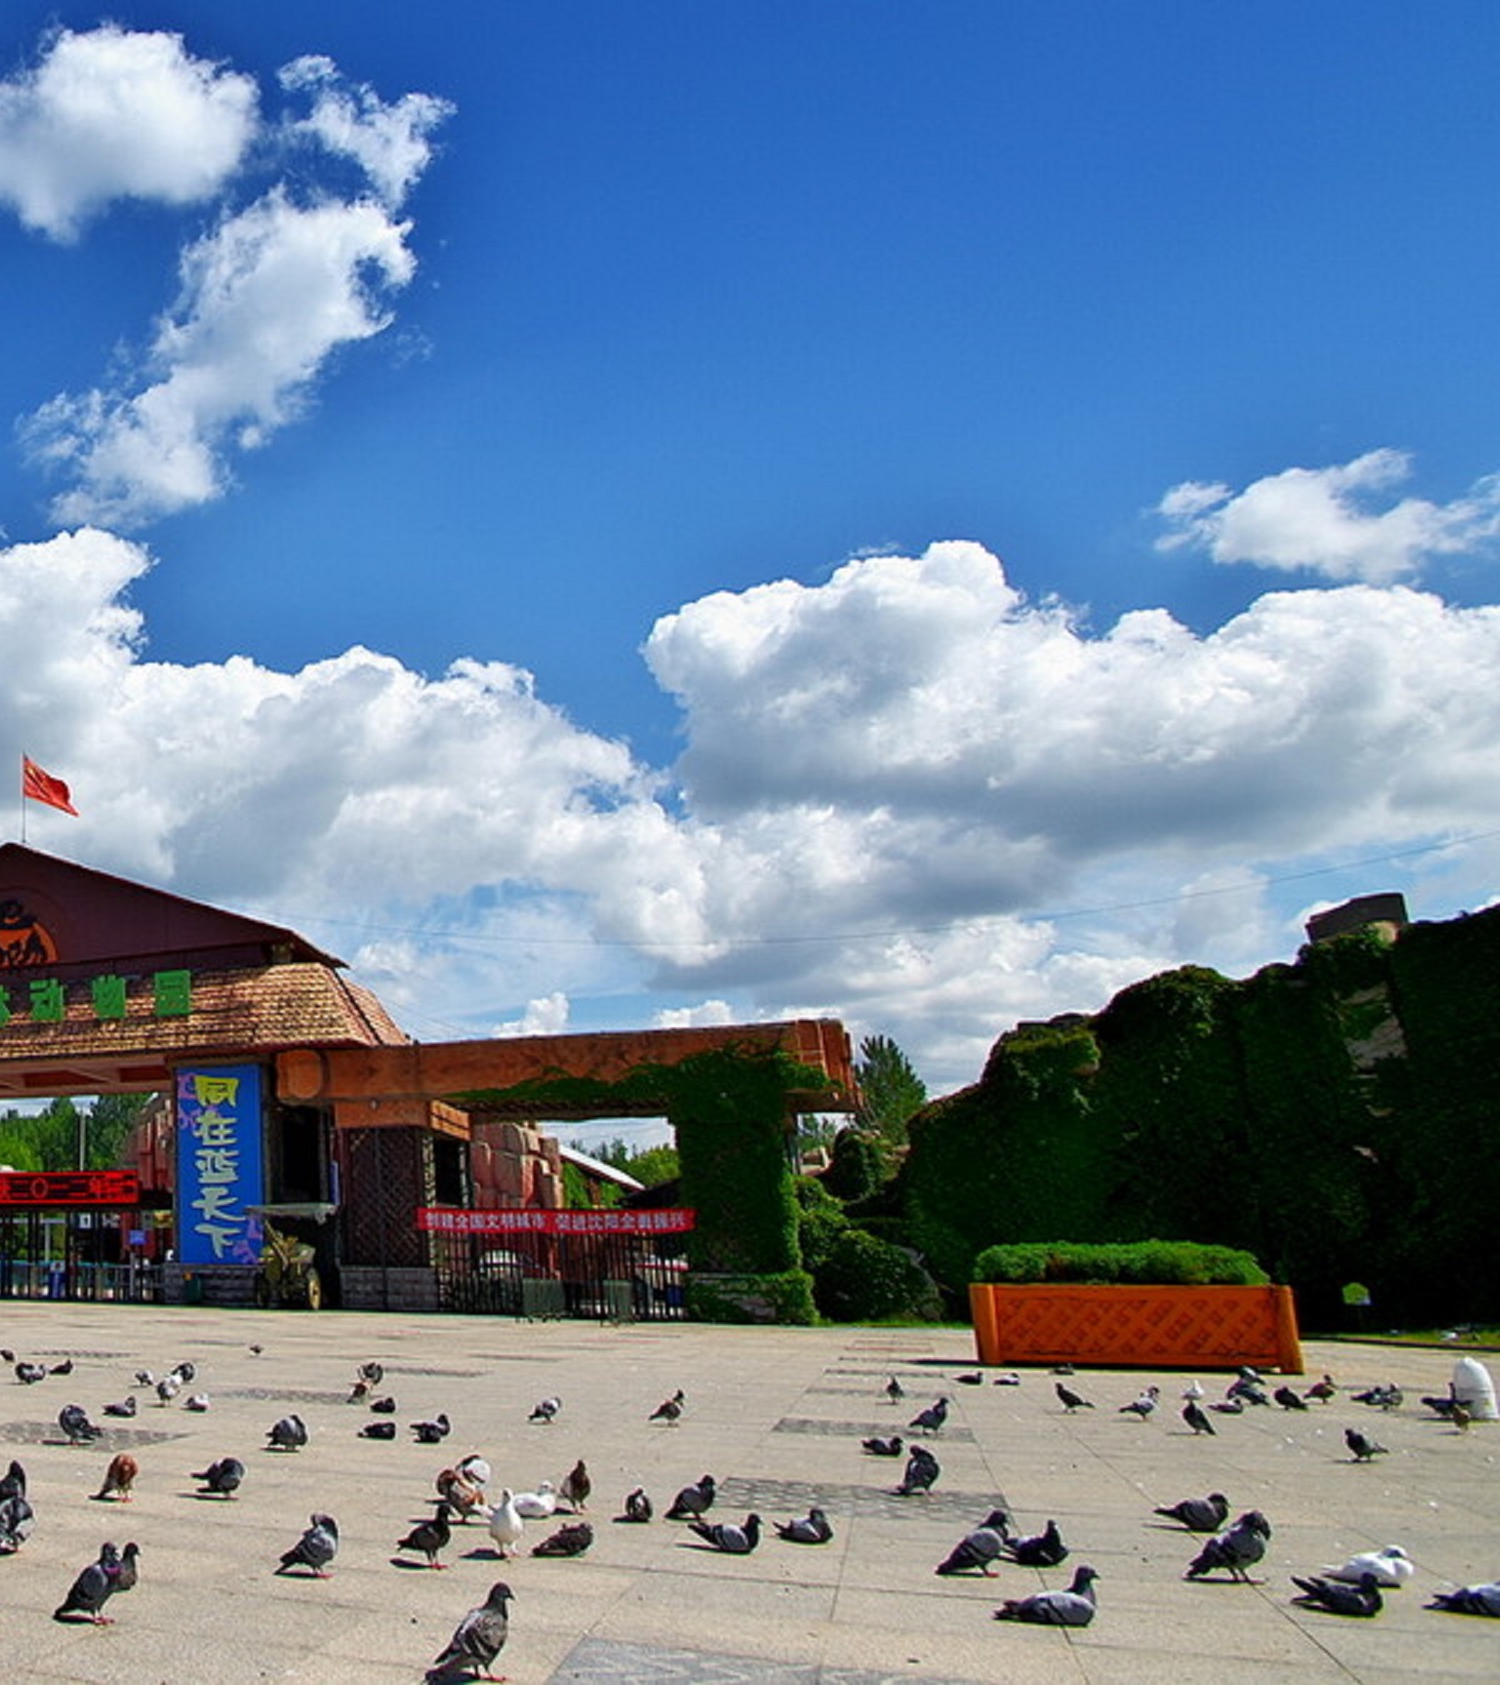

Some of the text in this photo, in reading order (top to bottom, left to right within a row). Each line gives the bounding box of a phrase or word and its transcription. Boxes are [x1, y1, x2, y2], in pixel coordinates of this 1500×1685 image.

[192, 1075, 247, 1259] 同在蓝天下
